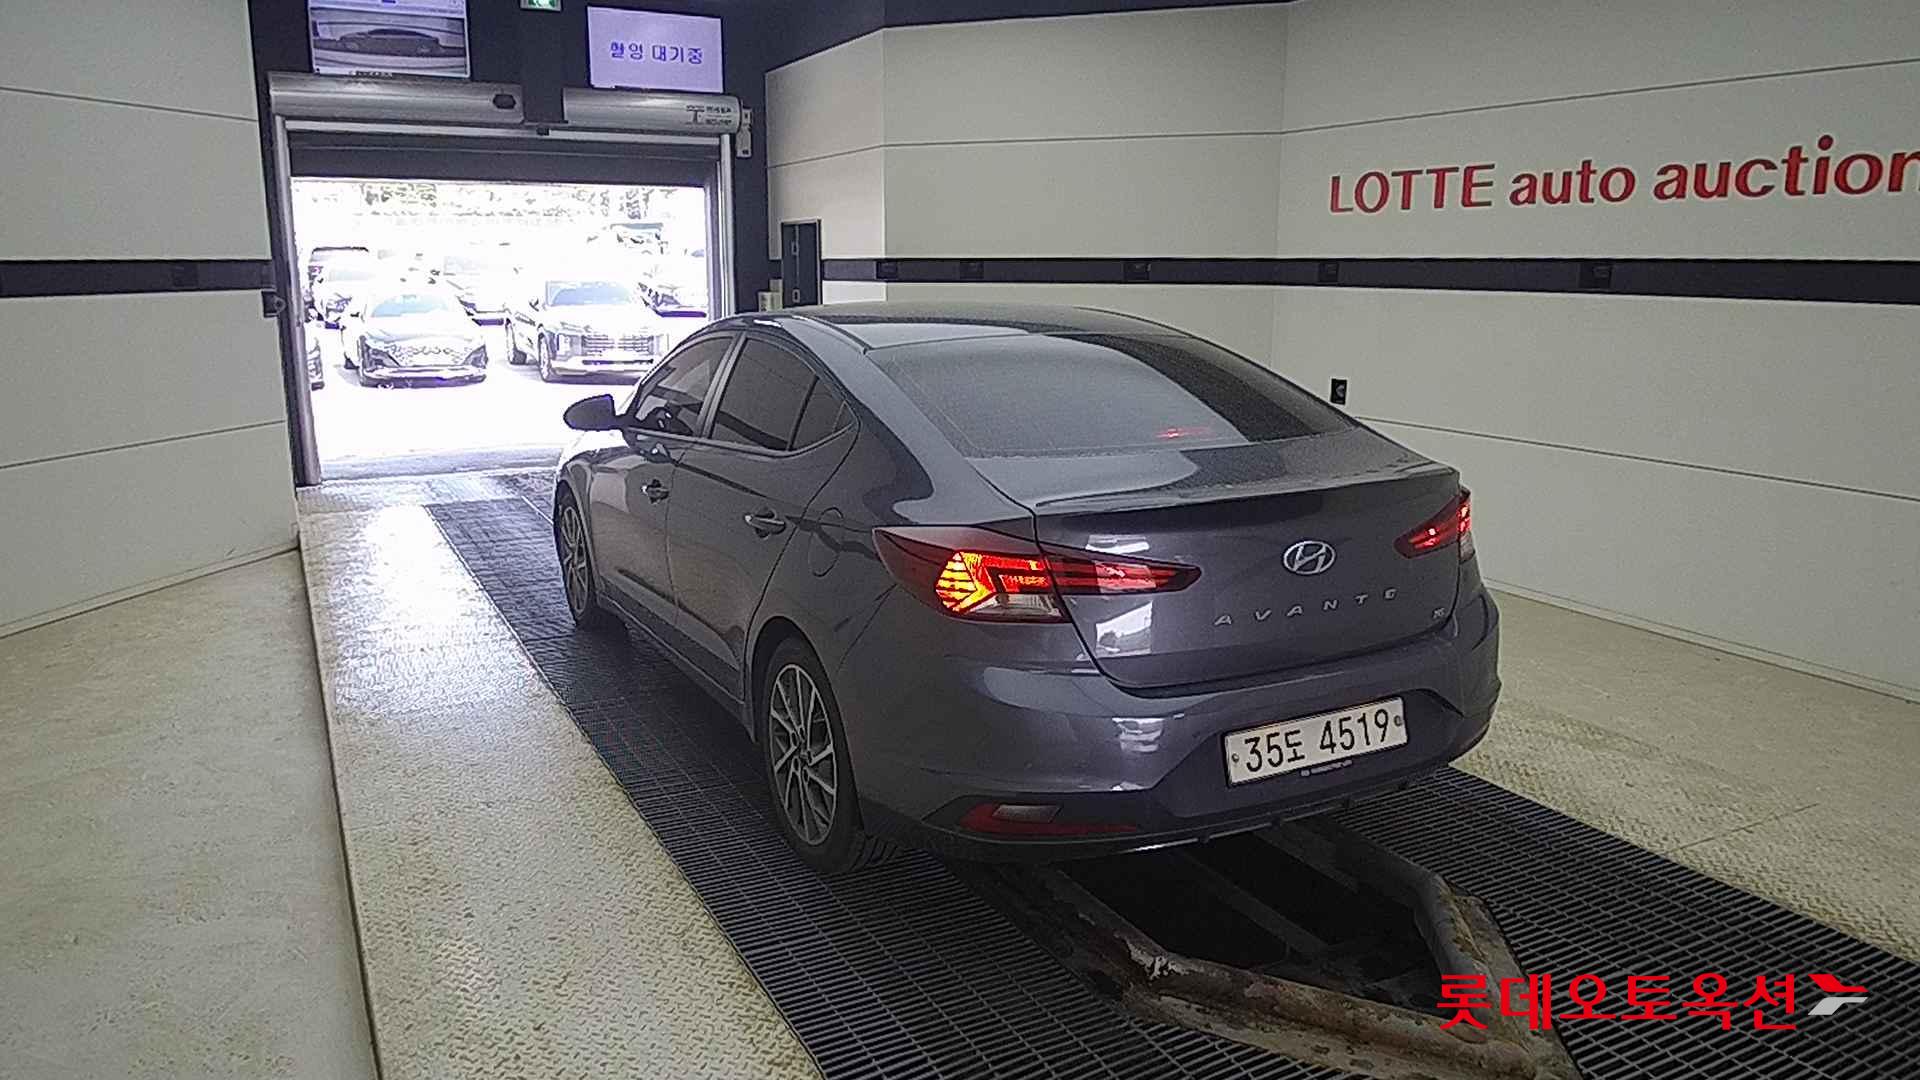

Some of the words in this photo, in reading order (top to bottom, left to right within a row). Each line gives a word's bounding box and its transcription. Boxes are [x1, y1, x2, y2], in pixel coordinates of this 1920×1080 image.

[652, 44, 702, 65] 대기중
[1330, 164, 1495, 214] LOTTE
[1509, 160, 1636, 206] auto
[1213, 588, 1397, 626] AVANTE
[1244, 730, 1305, 772] 35도
[1319, 708, 1389, 754] 4519
